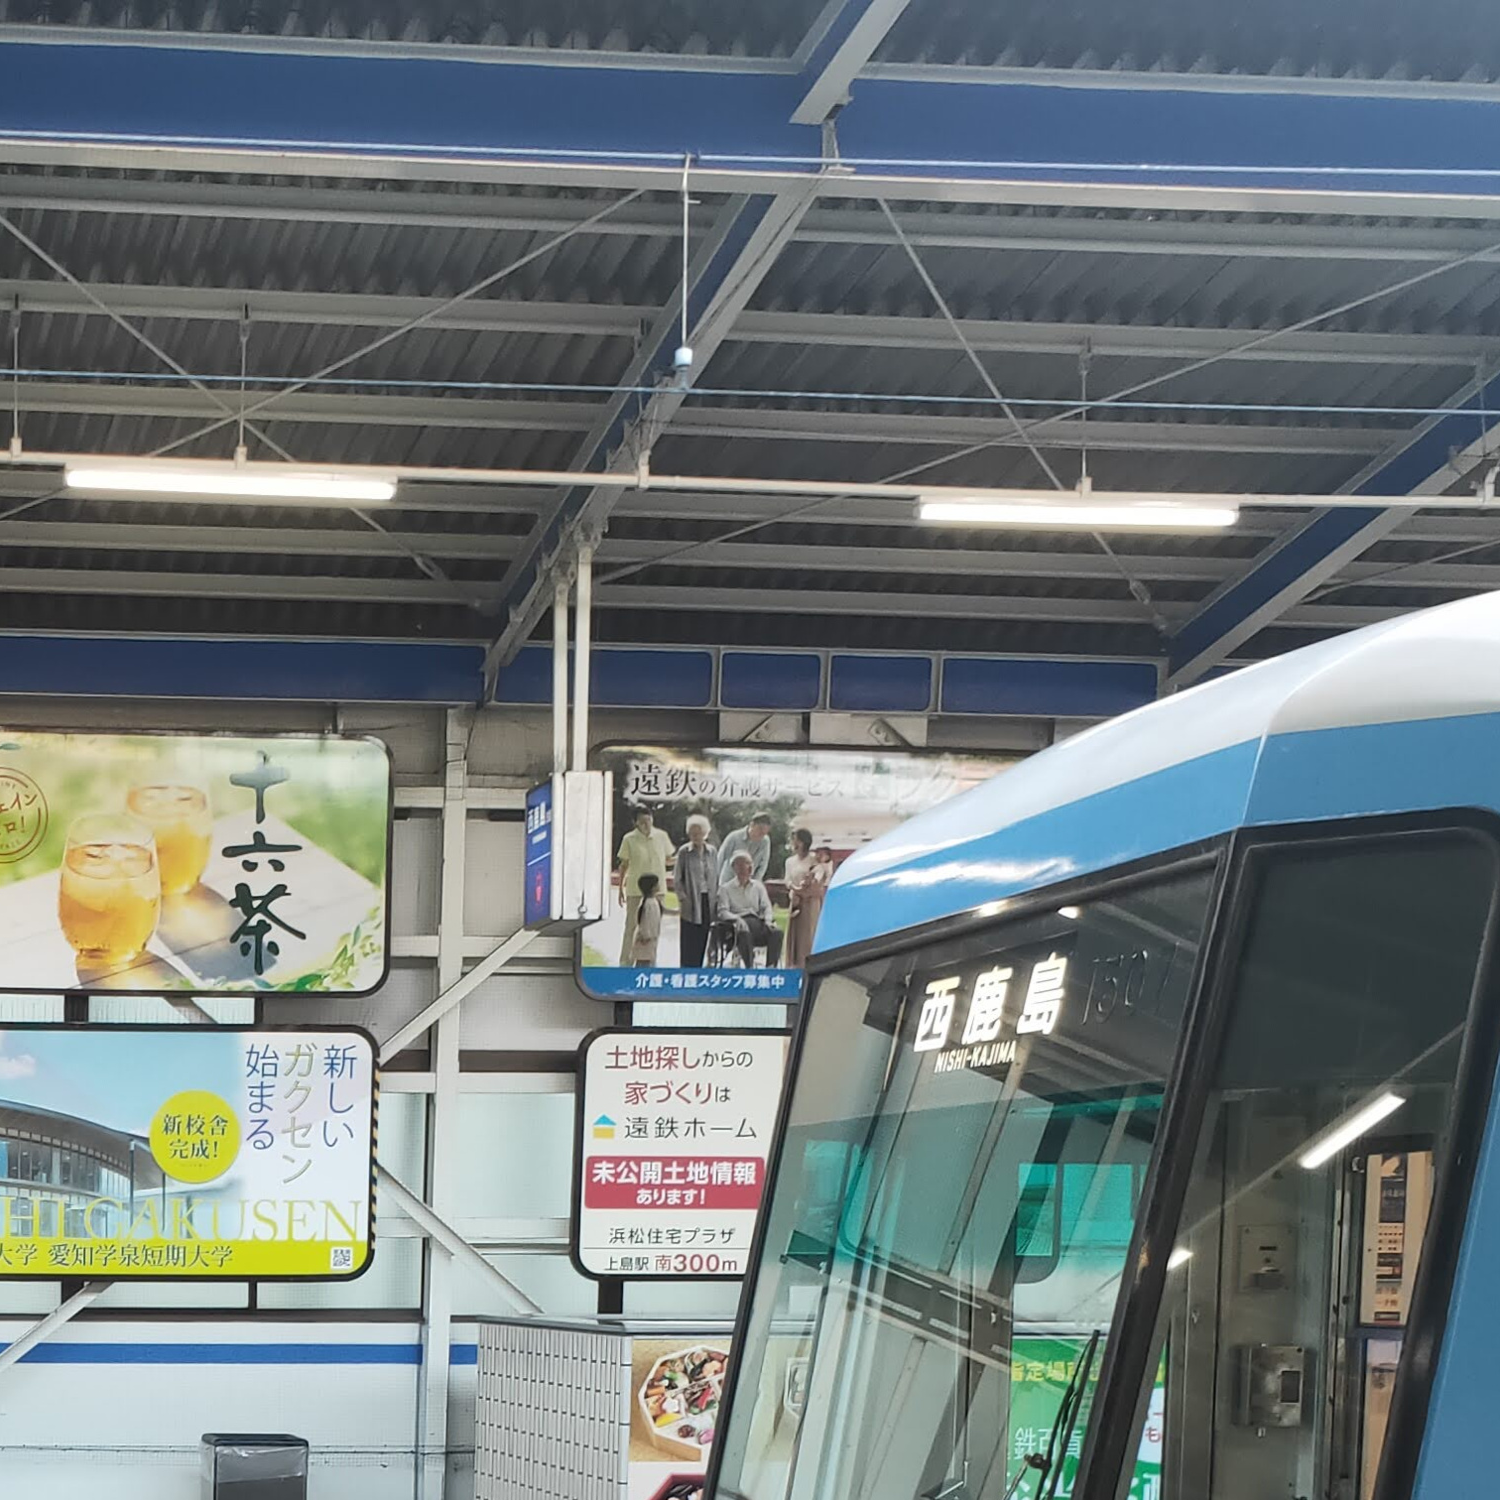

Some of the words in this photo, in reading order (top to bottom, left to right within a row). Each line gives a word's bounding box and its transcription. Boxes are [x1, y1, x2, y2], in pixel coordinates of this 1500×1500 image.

[630, 763, 845, 798] 遠鉄の介護サービス
[221, 750, 307, 976] 十六茶
[635, 973, 786, 989] 介護・看護スタッフ募集中
[913, 952, 1068, 1052] 西鹿島
[604, 1045, 753, 1071] 土地探しからの
[934, 1040, 1017, 1073] NISHI-KAJIMA
[246, 1043, 279, 1150] 始まる
[323, 1044, 357, 1148] 新しい
[624, 1081, 731, 1105] 家づくりは
[162, 1113, 229, 1135] 新校舎
[281, 1042, 318, 1184] ガクセン
[624, 1116, 758, 1139] 遠鉄ホーム
[592, 1160, 757, 1185] 未公開土地情報
[84, 1196, 363, 1242] GAKUSEN
[608, 1227, 736, 1244] 浜松住宅プラザ
[48, 1243, 233, 1267] 愛知学泉短期大学
[604, 1255, 649, 1271] 上島駅
